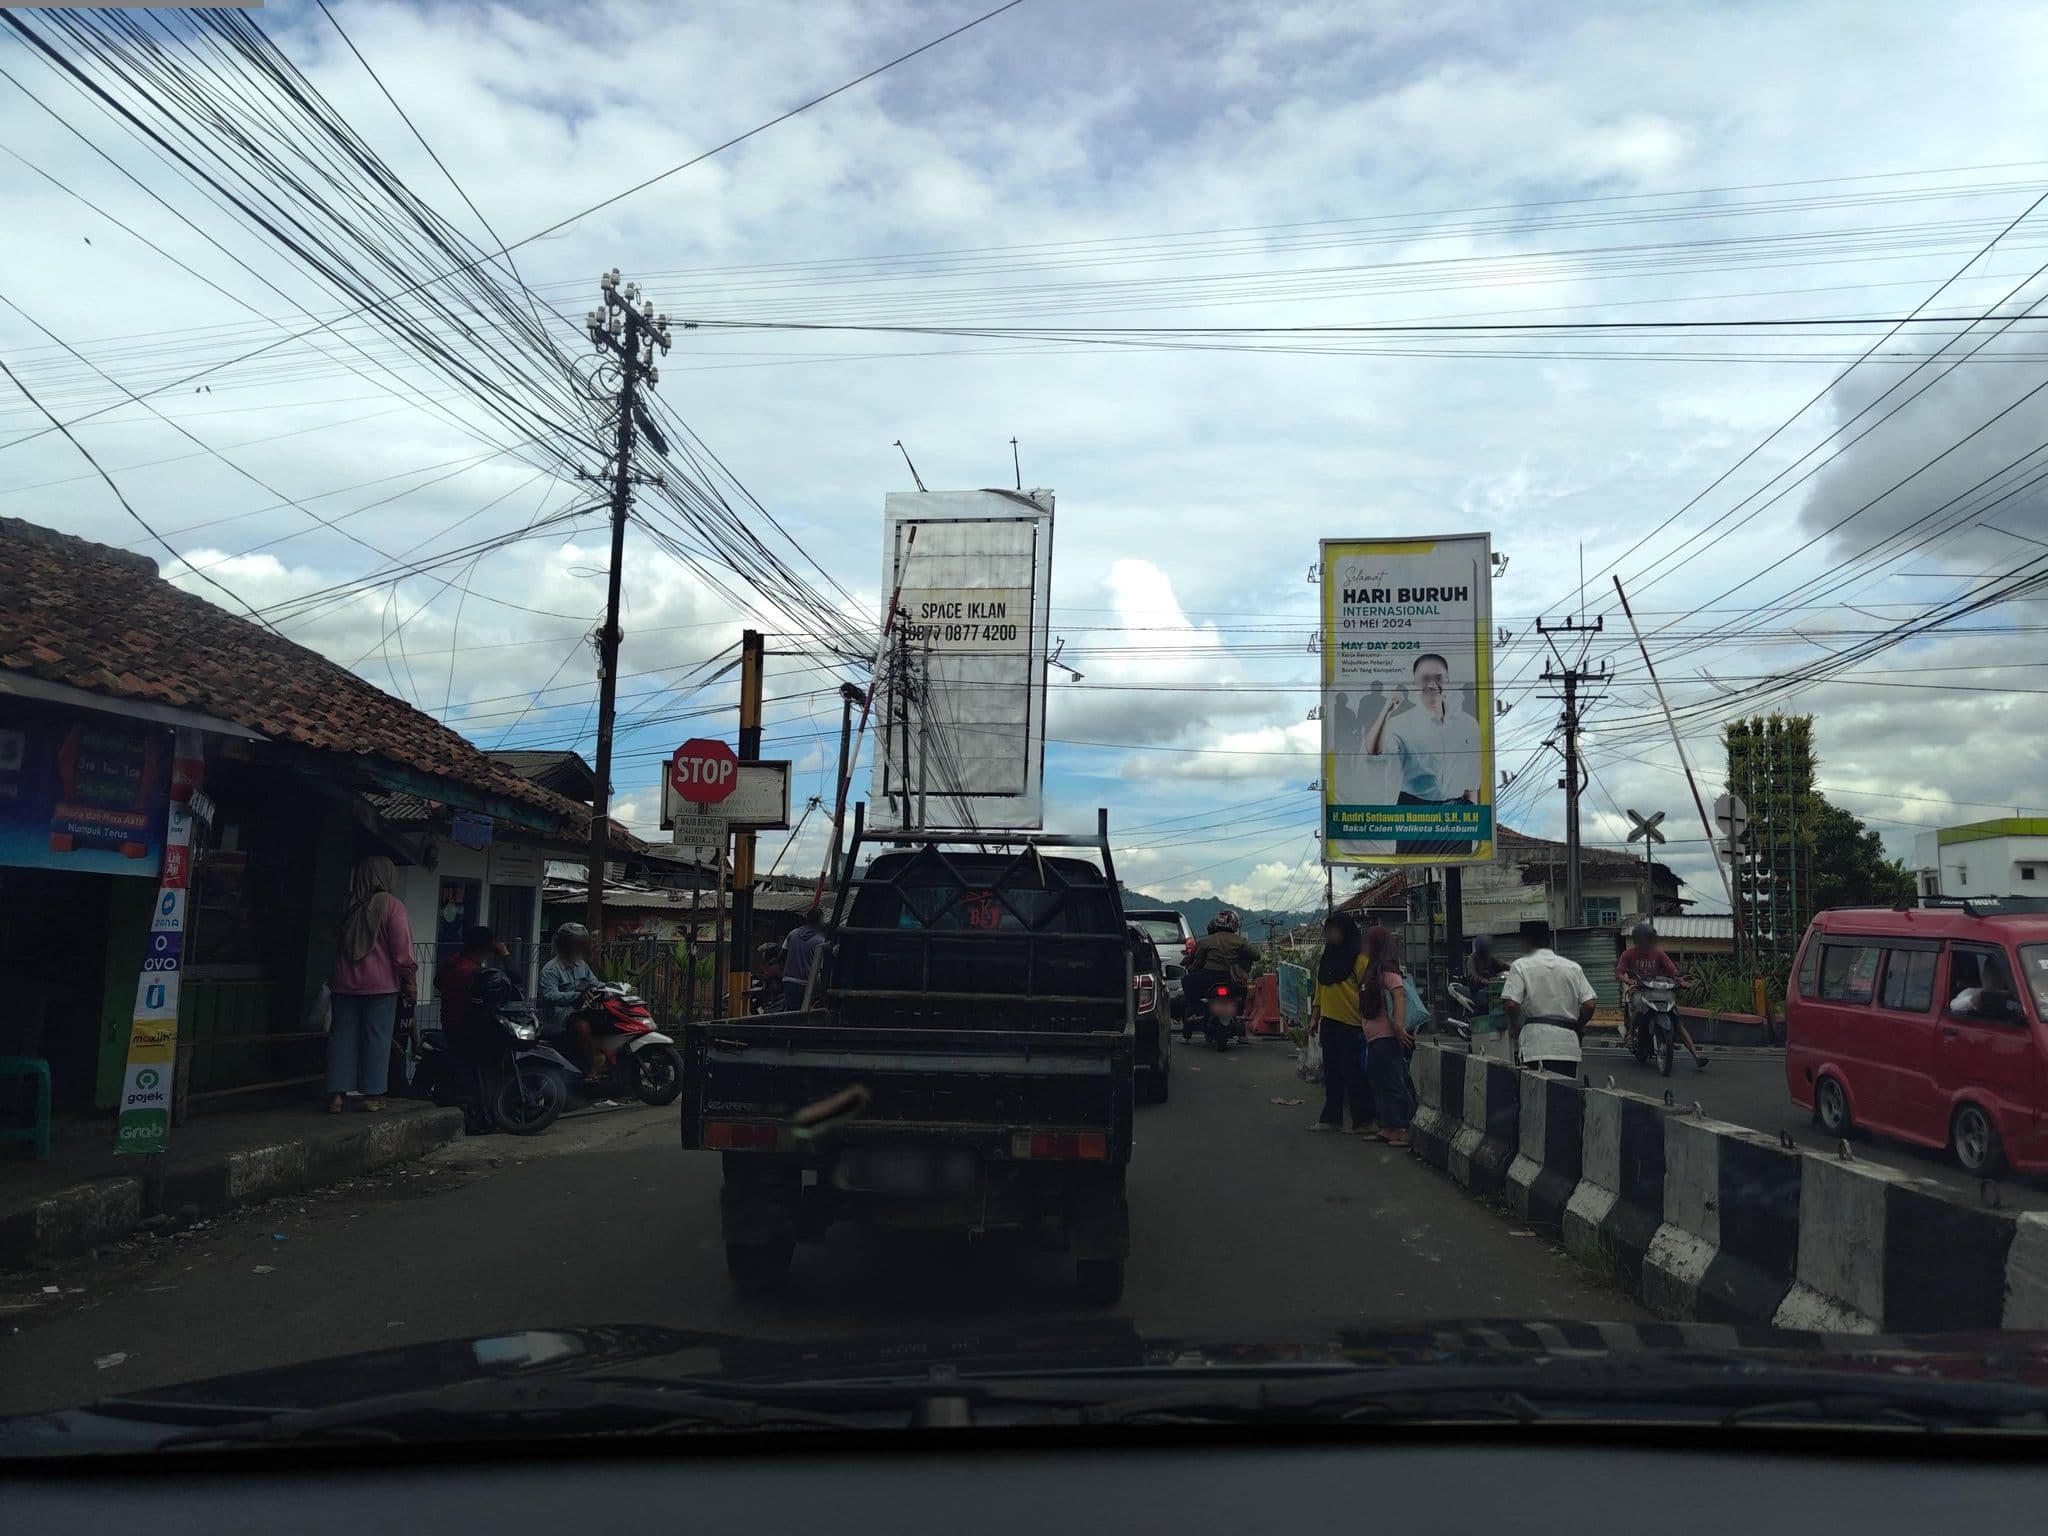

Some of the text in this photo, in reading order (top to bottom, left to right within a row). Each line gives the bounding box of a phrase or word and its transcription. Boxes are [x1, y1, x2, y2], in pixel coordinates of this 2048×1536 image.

[1343, 566, 1391, 587] Selamat
[1343, 586, 1468, 604] HARI BURUH
[921, 602, 1006, 619] SPACE IKLAN
[1343, 605, 1441, 617] INTERNASIONAL
[1343, 619, 1412, 628] 01 MEI 2024
[945, 624, 979, 641] 0877
[982, 624, 1017, 641] 4200
[1341, 641, 1421, 650] MAY DAY 2024
[677, 756, 733, 785] STOP
[1342, 812, 1364, 822] Andri
[1366, 812, 1405, 822] Setiawan
[68, 822, 128, 839] Numpuk Terus
[1343, 824, 1478, 833] Bakal Calon Walikota Sukabumi
[144, 958, 177, 971] OVO
[133, 1033, 169, 1044] maxim
[127, 1091, 165, 1105] gojek
[119, 1124, 165, 1140] Grab
